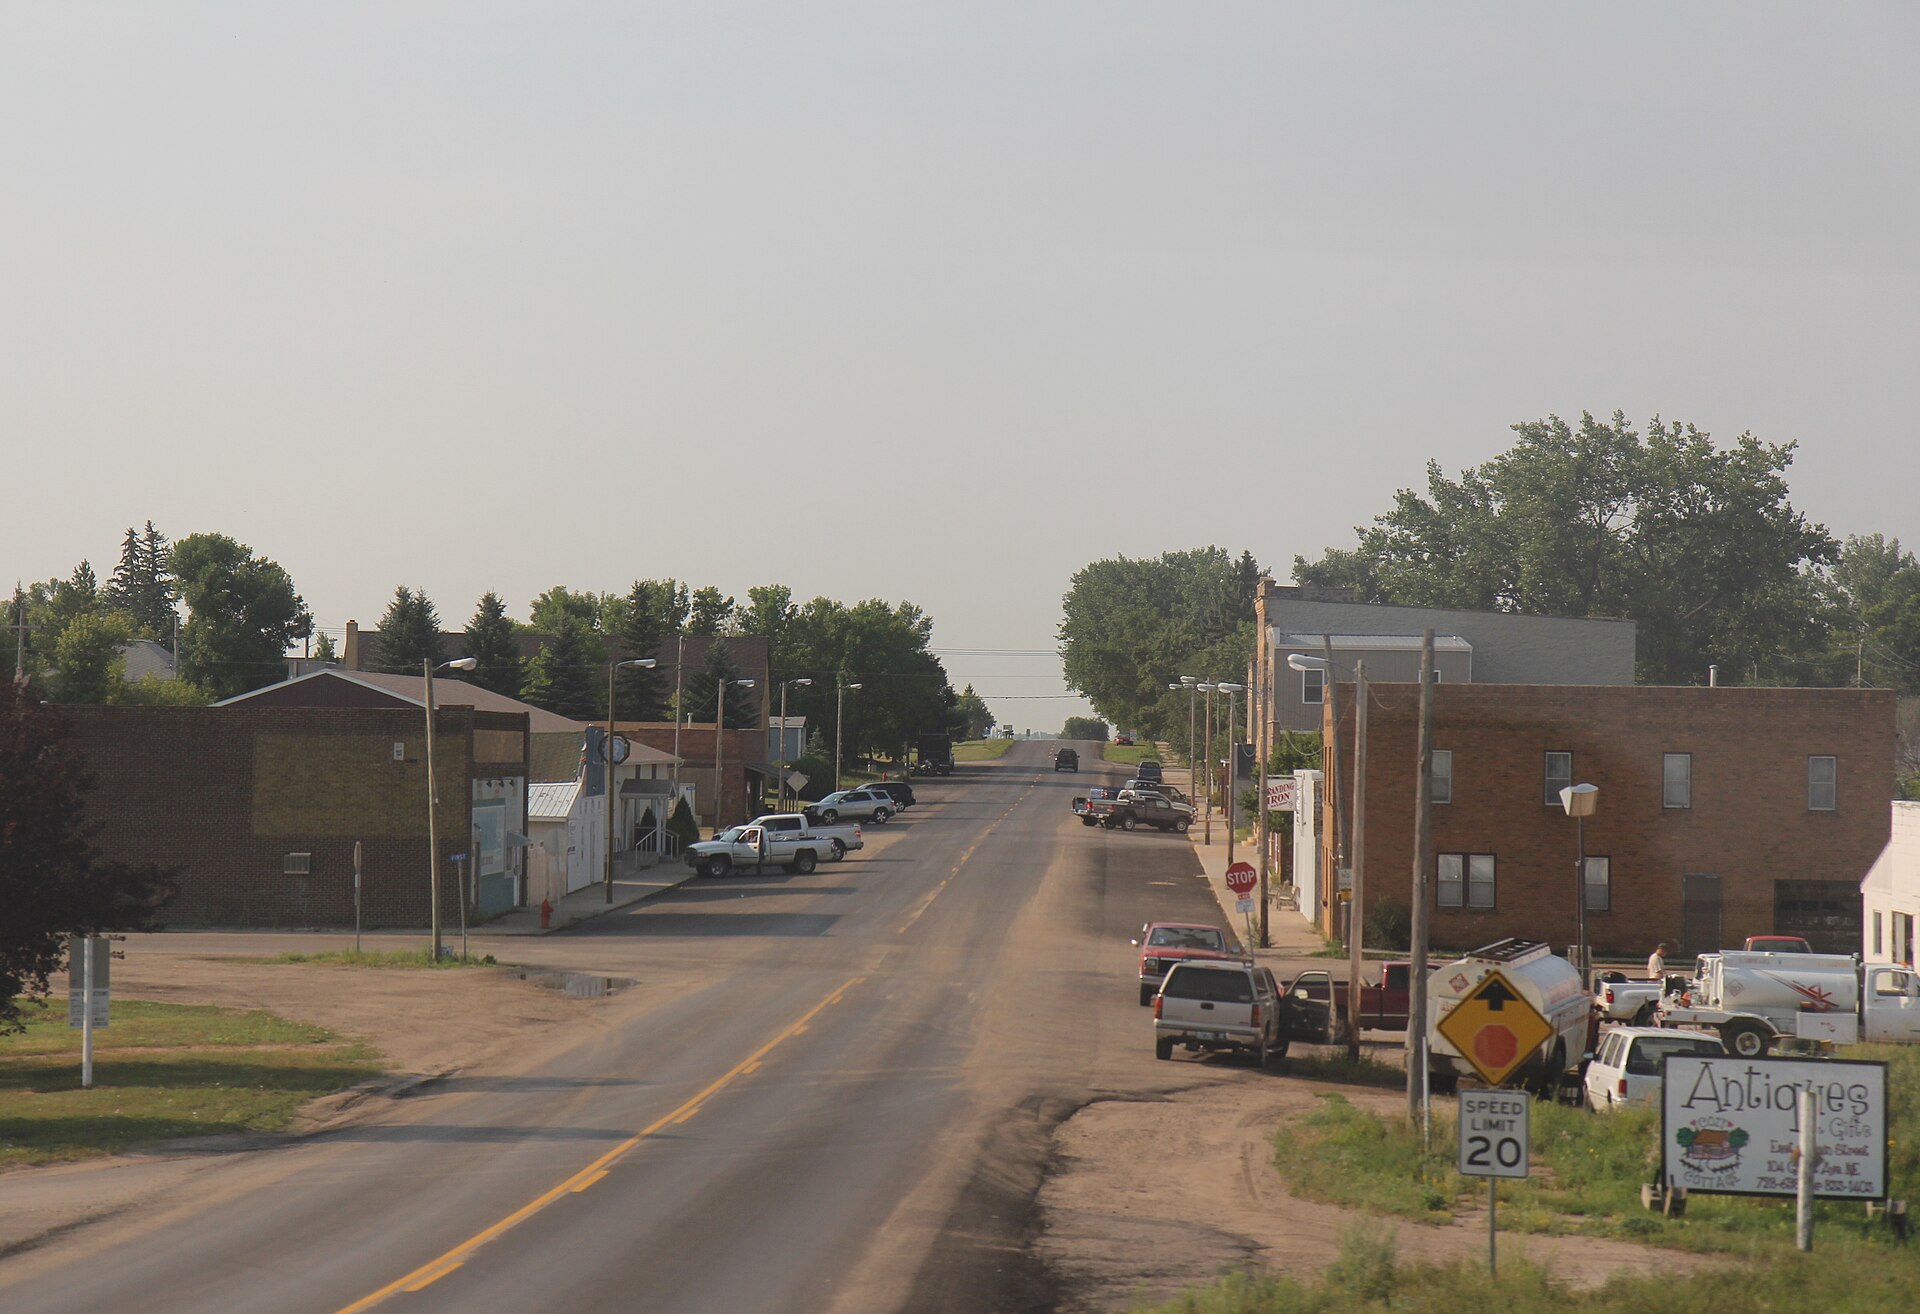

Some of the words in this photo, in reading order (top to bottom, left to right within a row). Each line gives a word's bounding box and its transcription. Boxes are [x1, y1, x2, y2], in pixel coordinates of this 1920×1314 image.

[1267, 782, 1294, 796] RANDING
[1267, 792, 1290, 805] IRON
[1227, 870, 1255, 886] STOP
[1466, 1100, 1523, 1115] SPEED
[1471, 1118, 1516, 1132] LIMIT
[1467, 1136, 1521, 1168] 20
